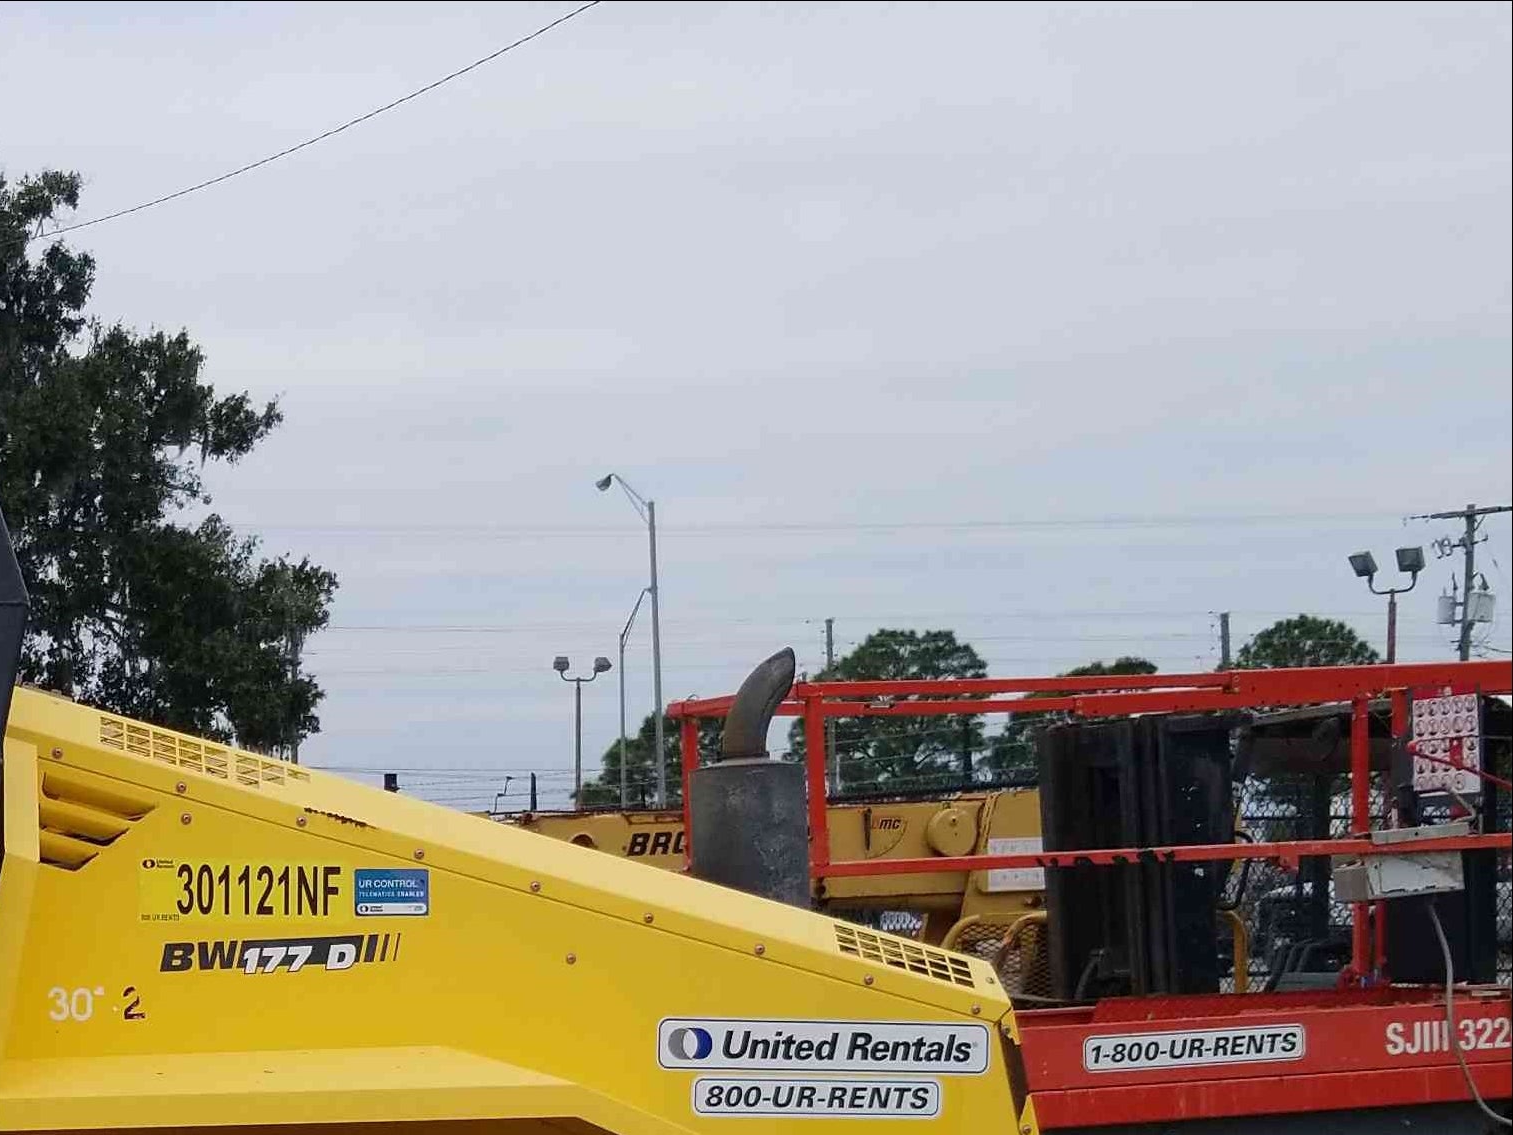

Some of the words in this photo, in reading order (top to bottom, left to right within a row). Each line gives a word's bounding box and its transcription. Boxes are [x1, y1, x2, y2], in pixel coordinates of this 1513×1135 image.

[176, 863, 341, 917] 301121NF
[374, 879, 419, 888] CONTROL
[122, 986, 147, 1020] 2
[722, 1030, 840, 1061] United
[846, 1032, 972, 1063] Rentals
[1090, 1031, 1298, 1065] 1-800-UR-RENTS
[704, 1085, 930, 1110] 800-UR-RENTS
